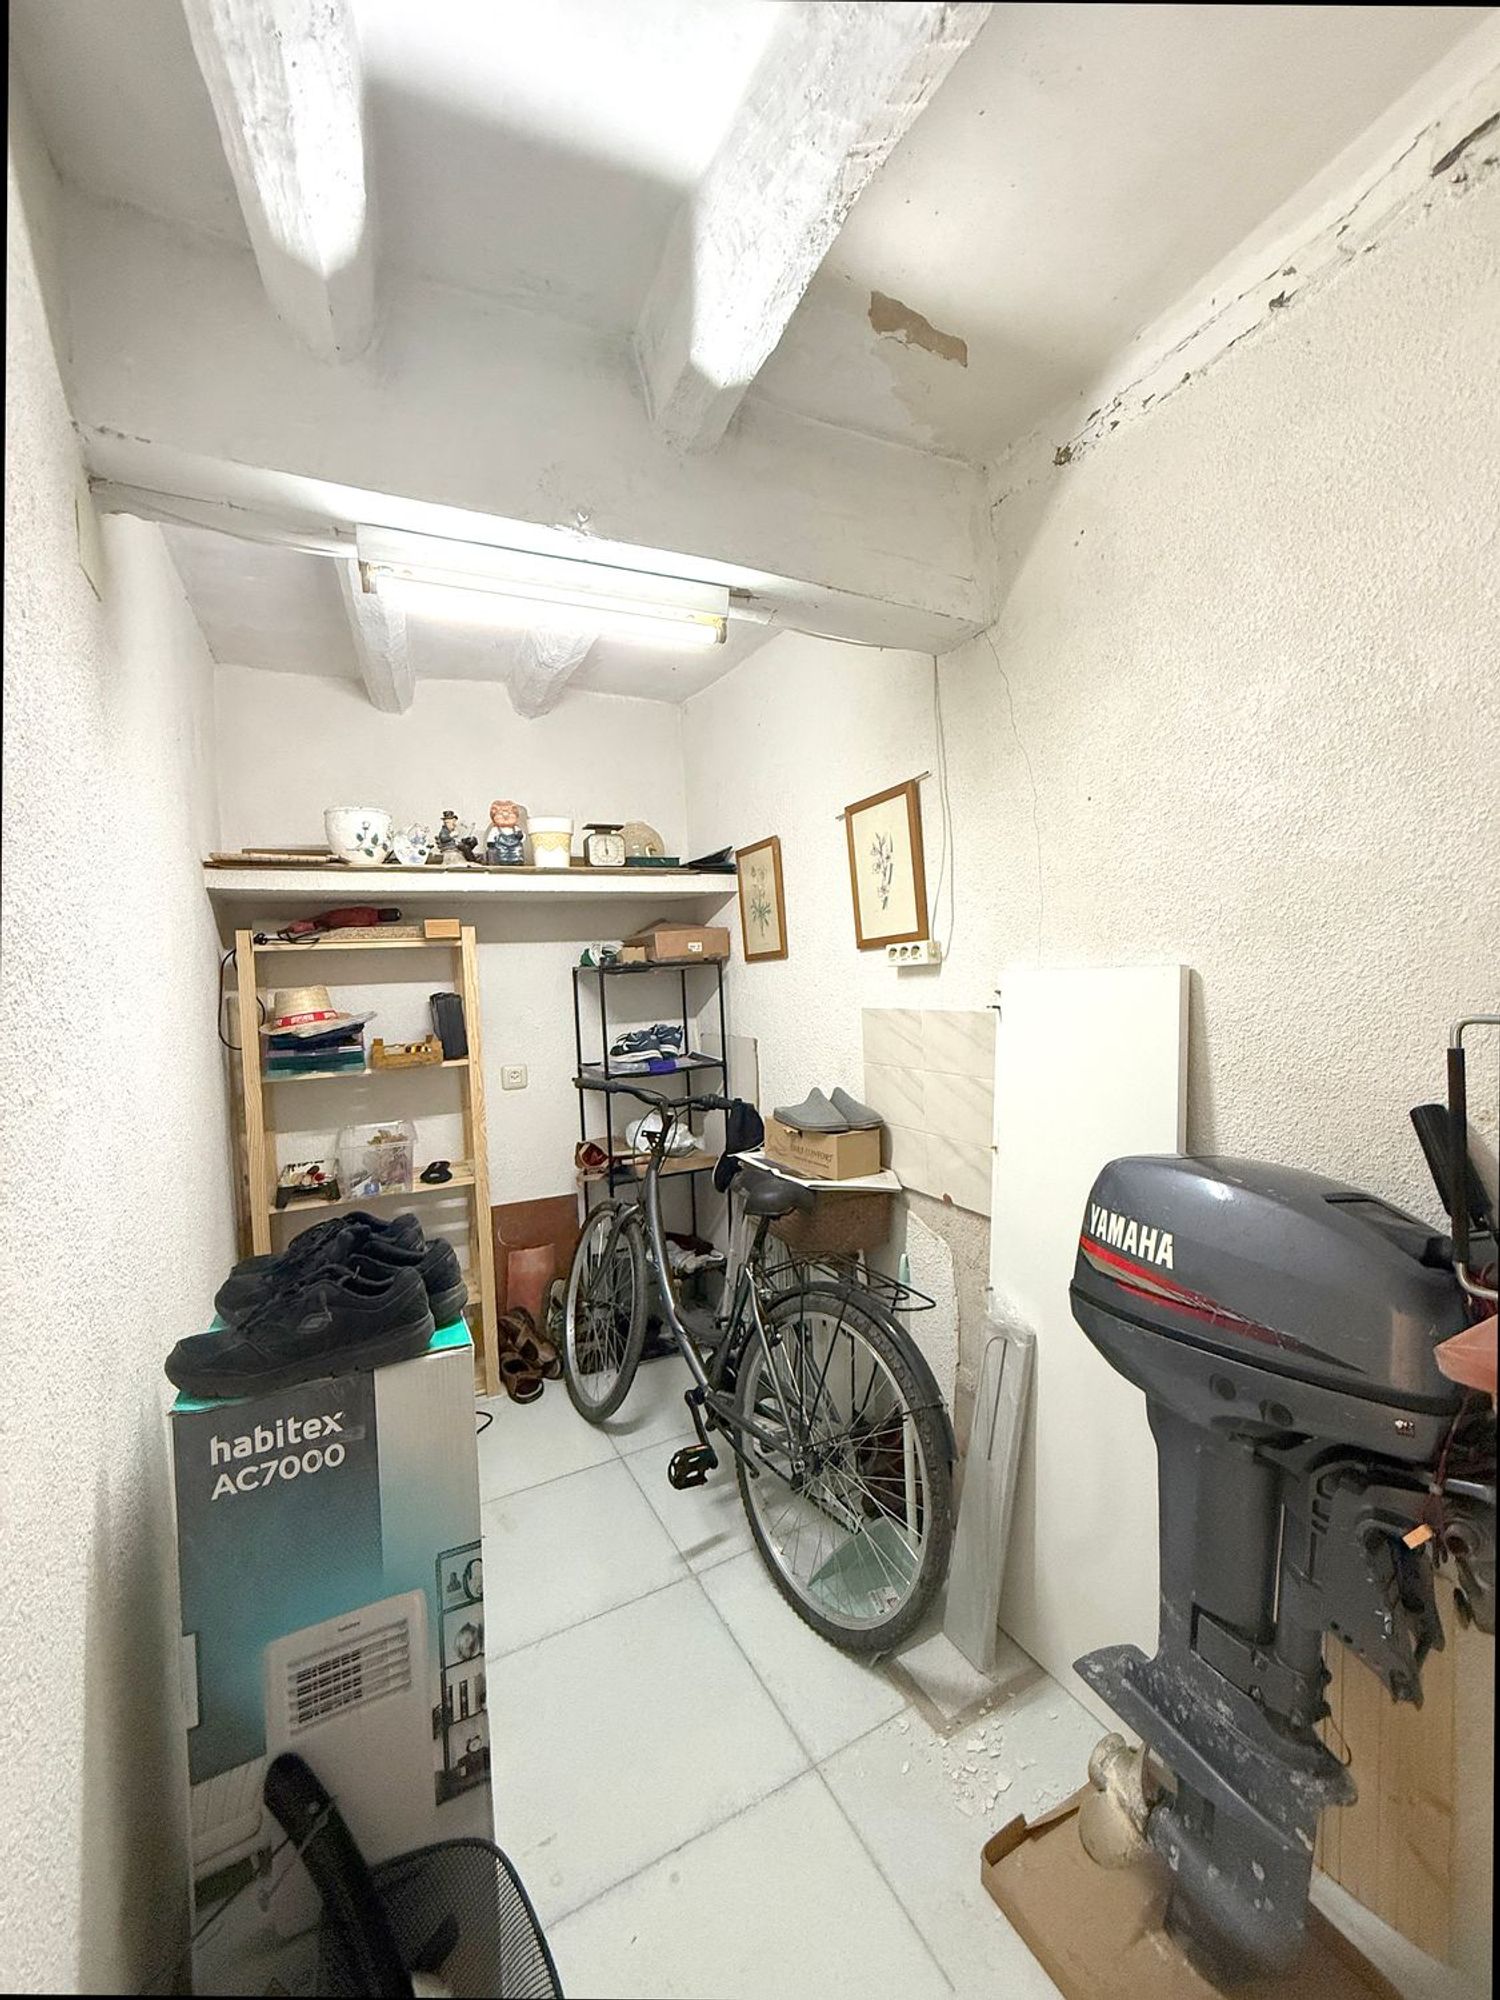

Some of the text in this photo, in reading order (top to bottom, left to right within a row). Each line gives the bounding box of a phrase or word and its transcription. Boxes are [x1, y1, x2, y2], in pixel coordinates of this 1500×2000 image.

[1090, 1203, 1174, 1270] YAMAHA
[210, 1411, 346, 1466] habitex
[211, 1443, 346, 1501] AC7000
